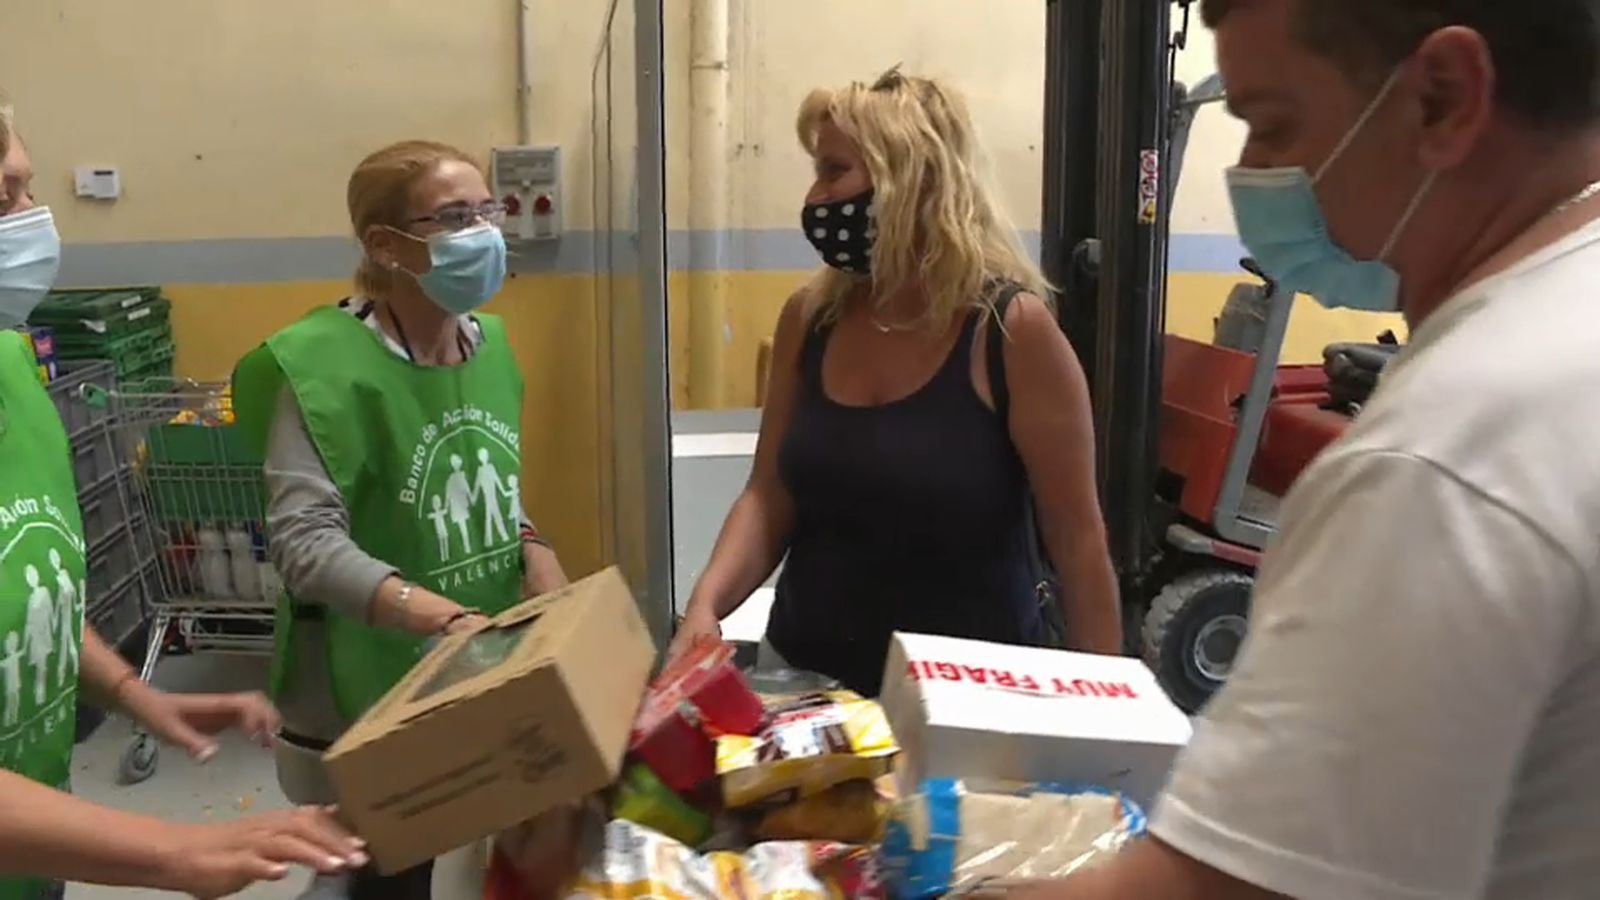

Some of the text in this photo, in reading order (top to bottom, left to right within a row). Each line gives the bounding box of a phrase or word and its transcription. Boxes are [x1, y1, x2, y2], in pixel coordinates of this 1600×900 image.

[400, 443, 426, 504] Banco
[422, 423, 438, 444] de
[1051, 677, 1138, 699] MUY
